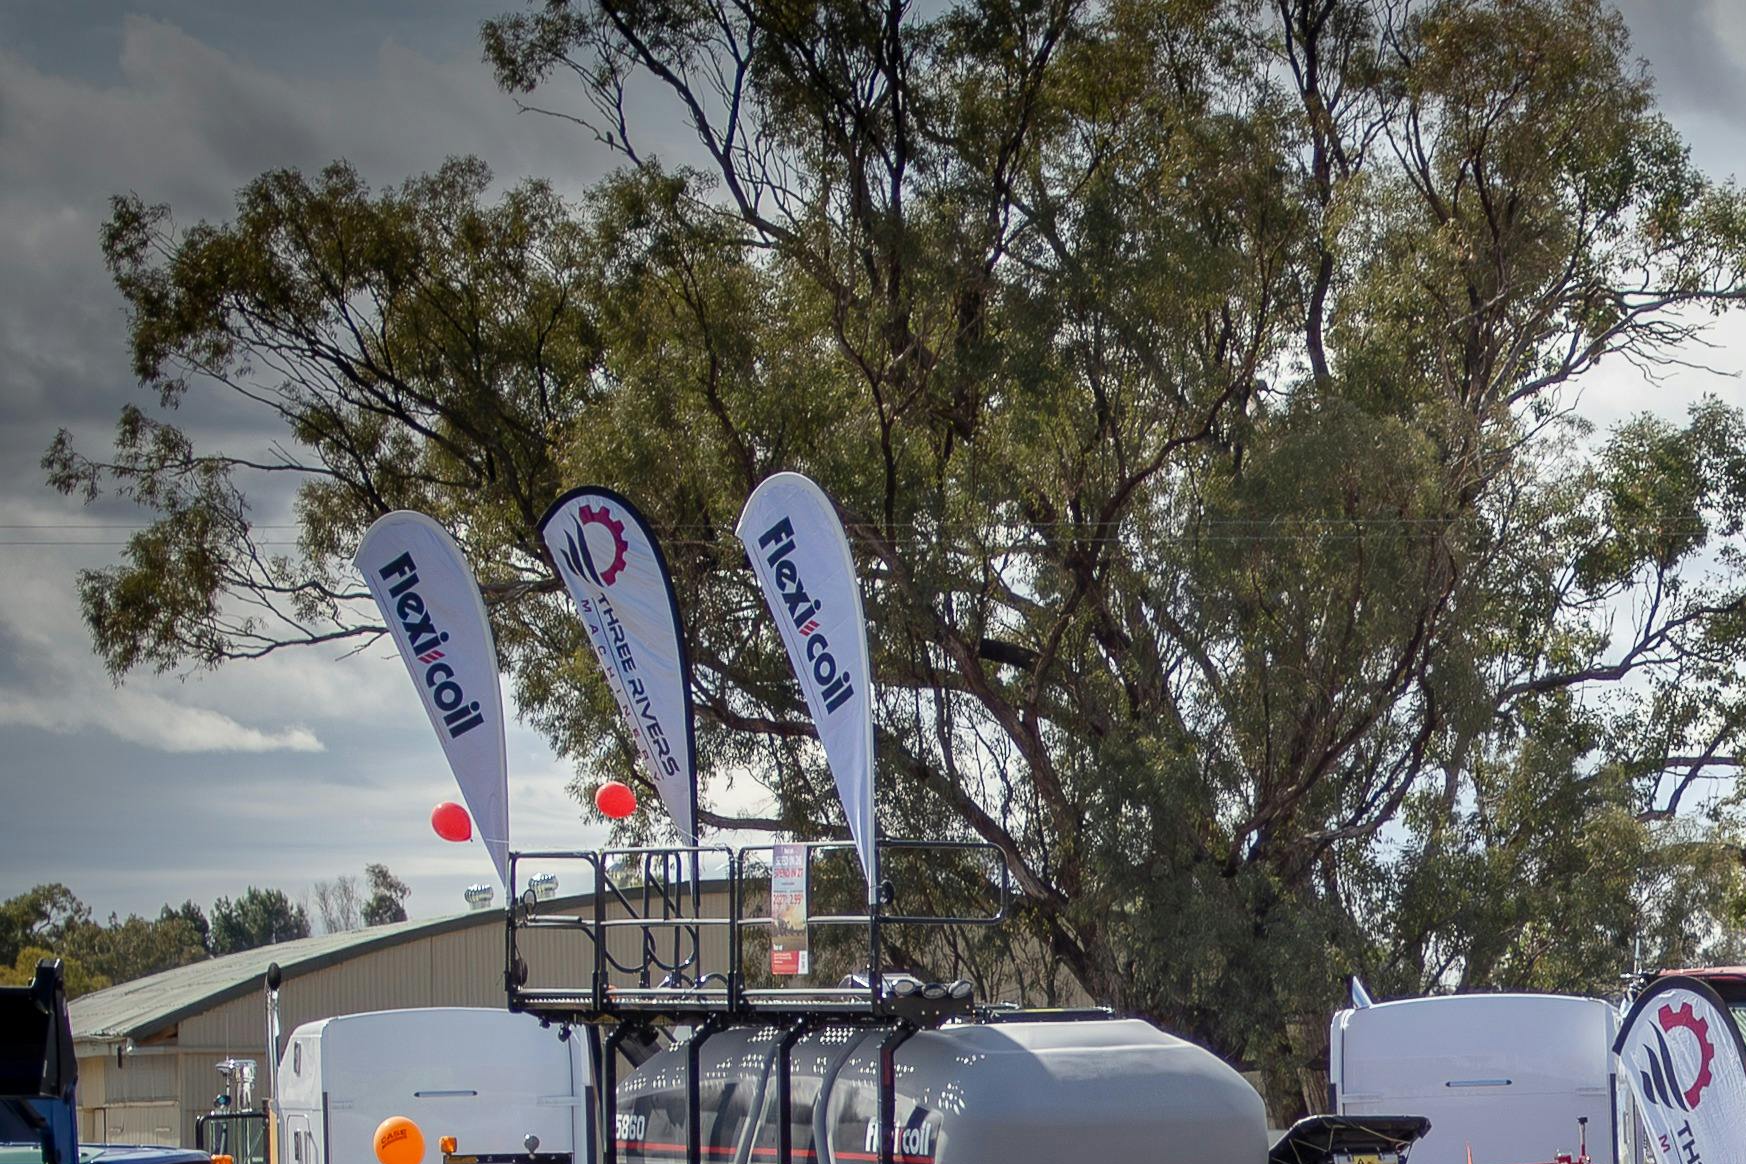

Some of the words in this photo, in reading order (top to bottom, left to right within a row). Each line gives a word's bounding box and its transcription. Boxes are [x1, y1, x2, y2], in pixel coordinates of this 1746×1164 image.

[581, 599, 660, 782] MACHINERY
[598, 592, 637, 673] THREE
[628, 677, 680, 777] RIVERS
[615, 1113, 646, 1141] 5860
